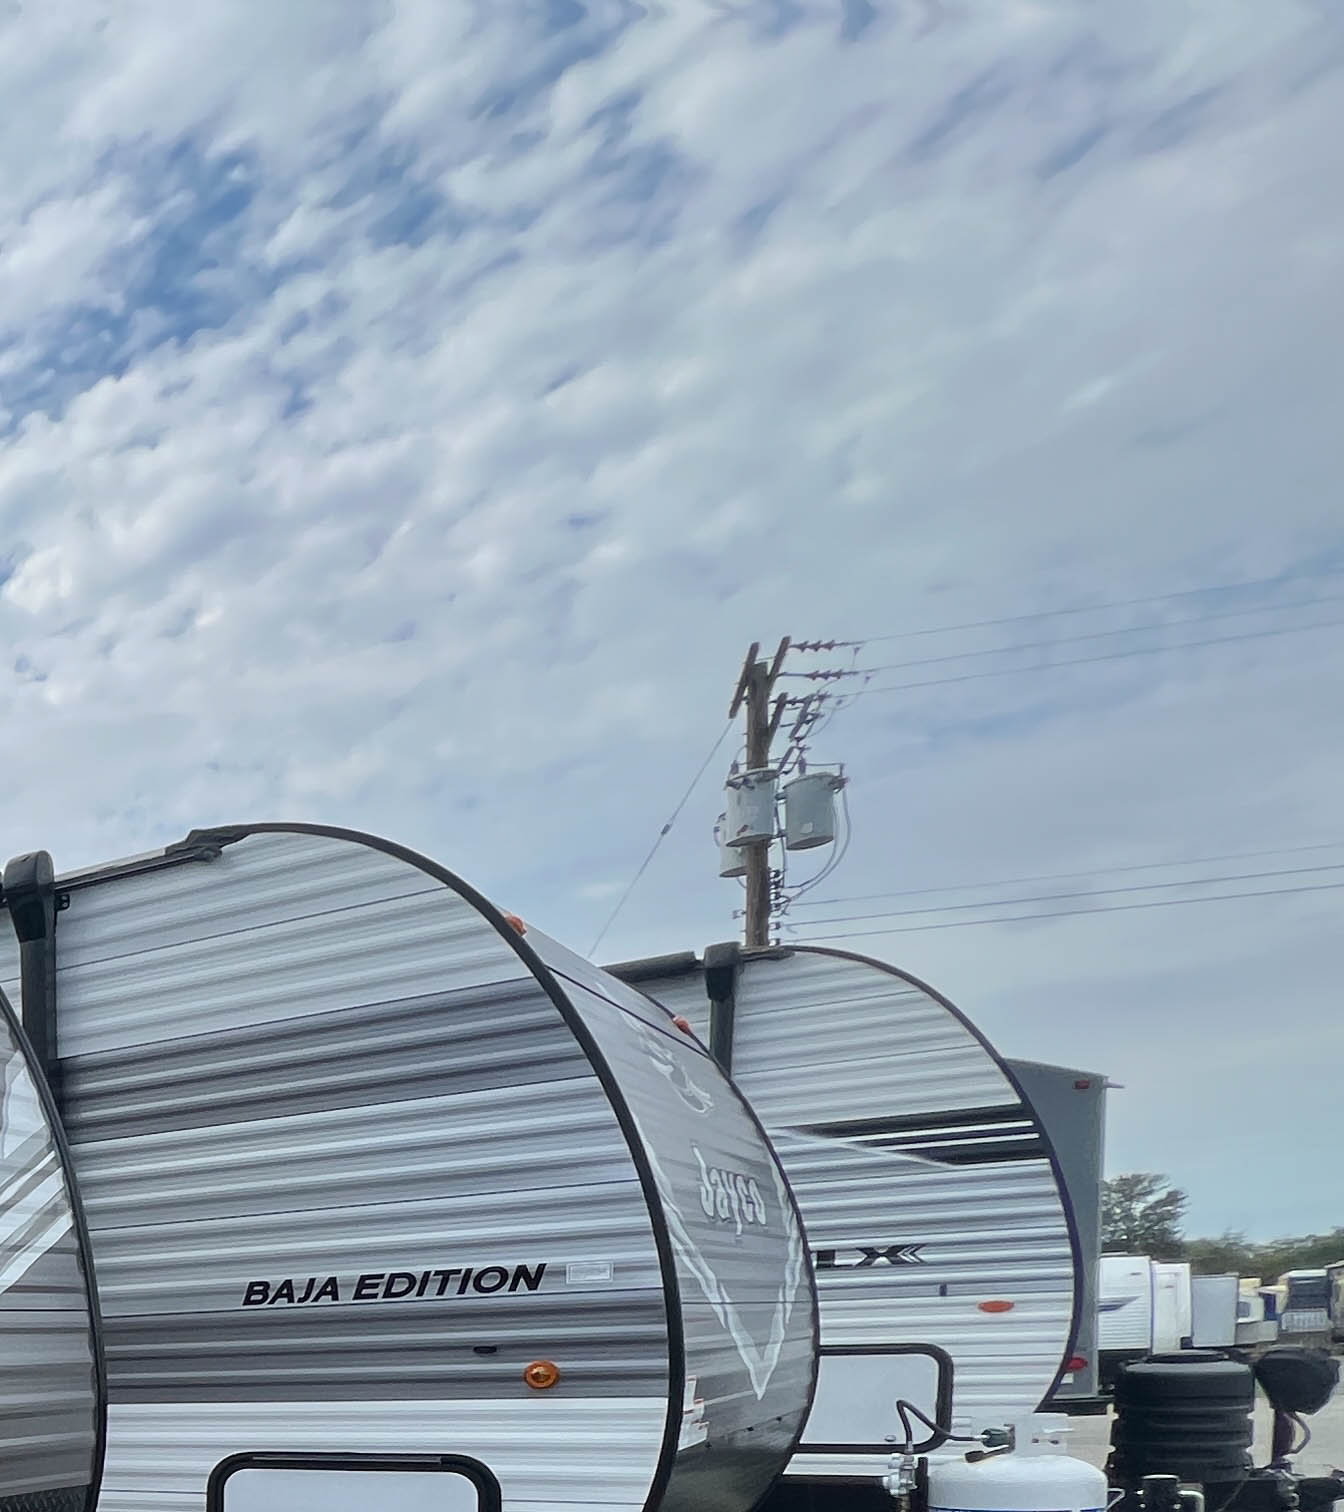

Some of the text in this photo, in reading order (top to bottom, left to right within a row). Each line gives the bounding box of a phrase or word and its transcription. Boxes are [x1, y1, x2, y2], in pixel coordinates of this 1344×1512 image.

[691, 1142, 767, 1237] Jayco
[242, 1262, 548, 1306] BAJA EDITION
